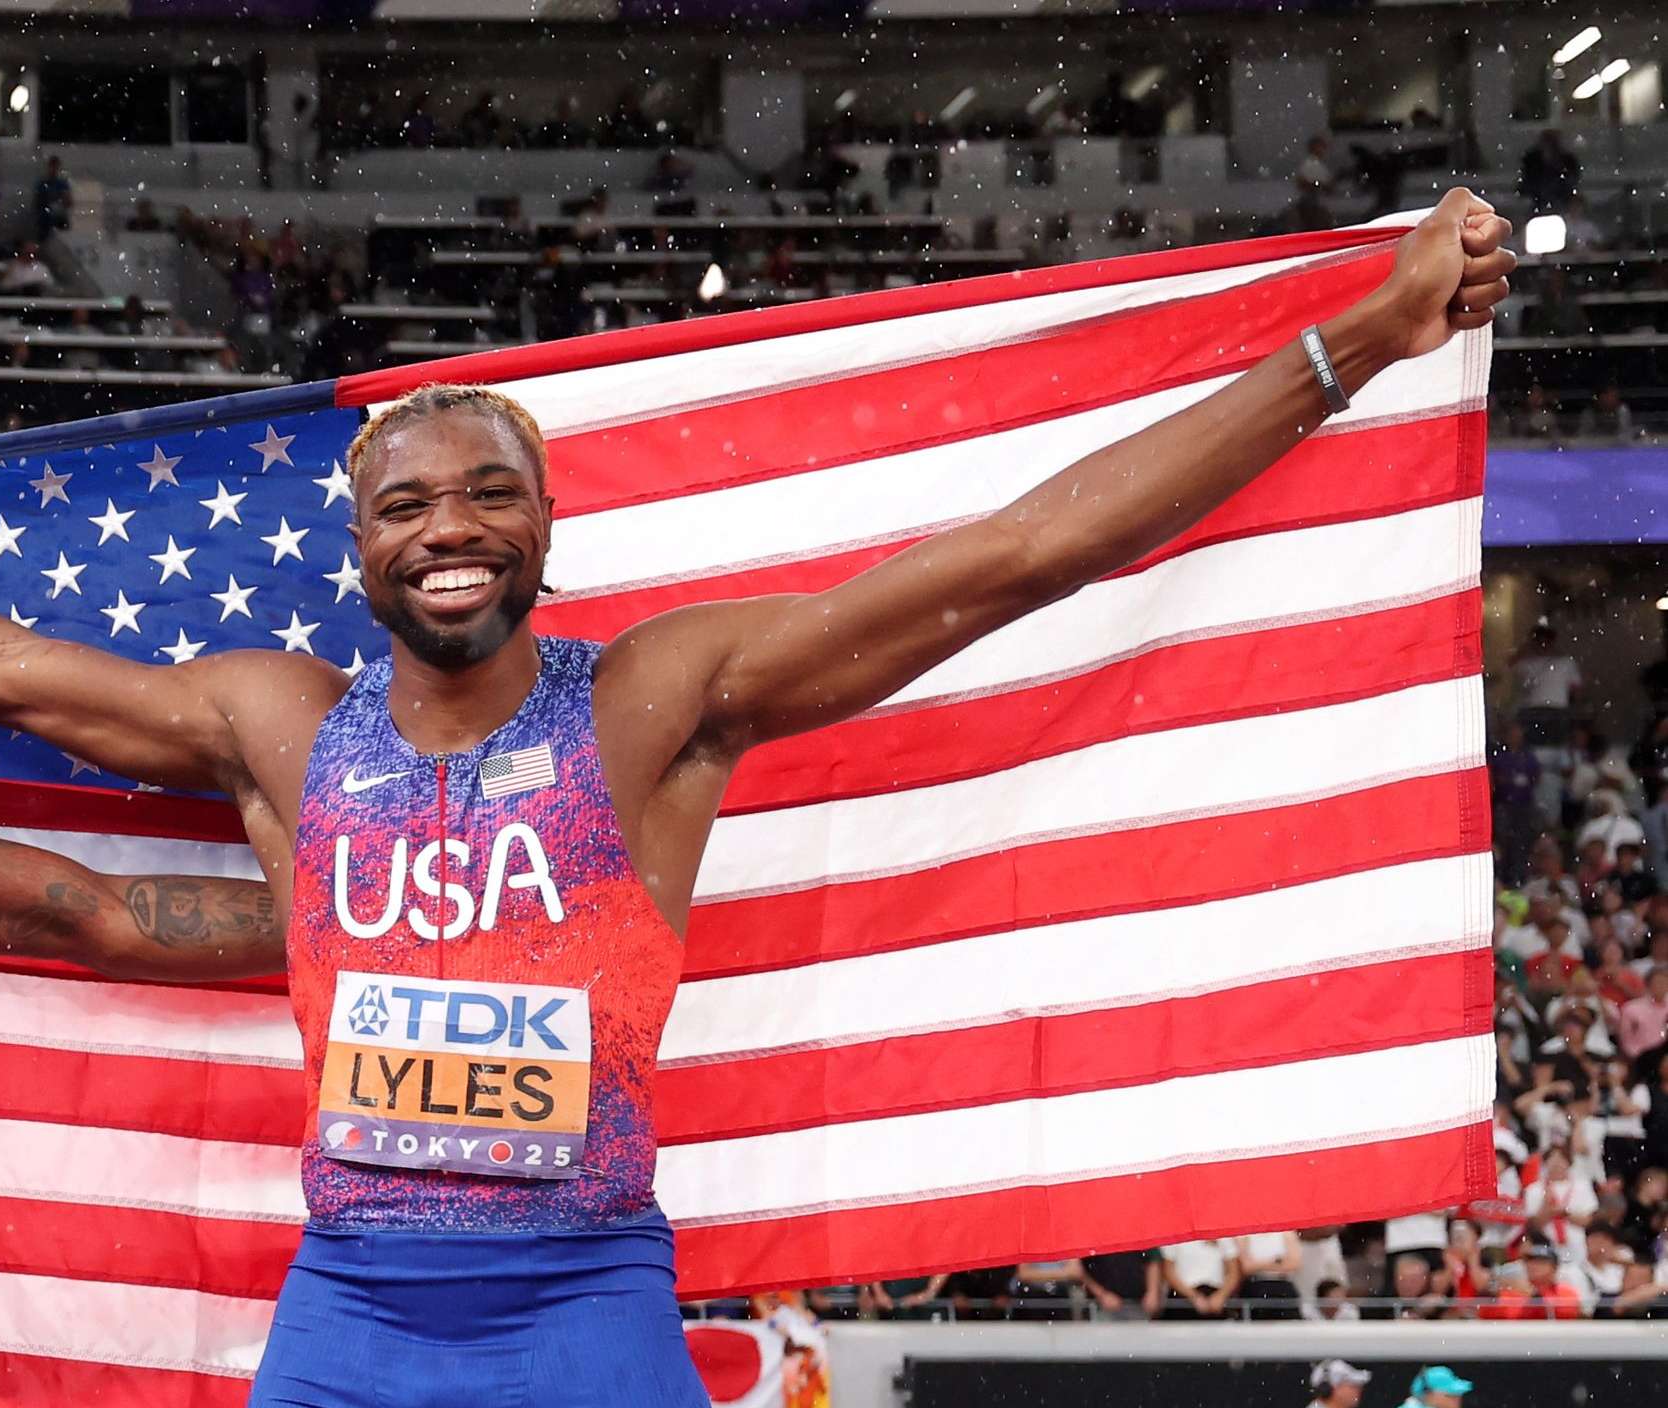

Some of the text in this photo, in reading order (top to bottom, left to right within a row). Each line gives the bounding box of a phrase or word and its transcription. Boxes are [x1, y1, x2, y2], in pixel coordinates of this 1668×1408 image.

[334, 823, 564, 940] USA
[392, 987, 568, 1051] TDK
[348, 1053, 554, 1122] LYLES
